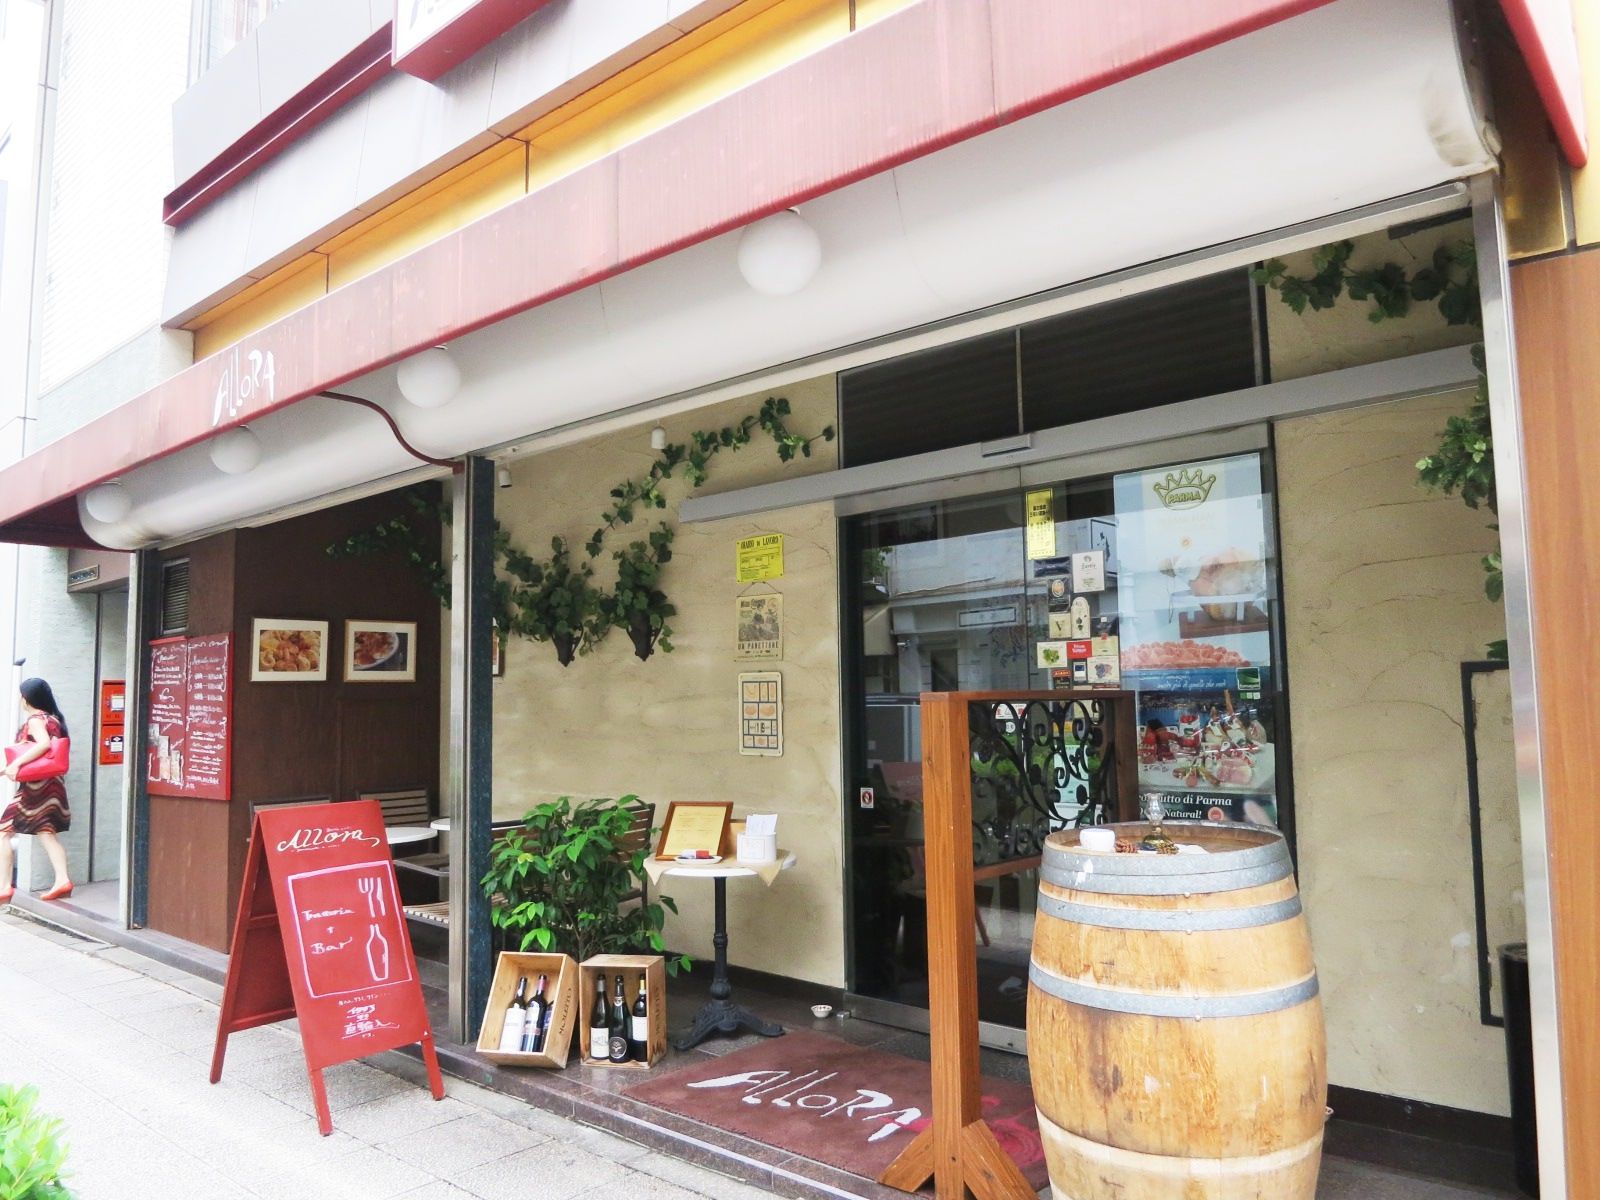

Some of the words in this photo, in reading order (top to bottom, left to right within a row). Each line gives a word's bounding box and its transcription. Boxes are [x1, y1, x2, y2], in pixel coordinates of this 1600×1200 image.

[1166, 490, 1202, 505] PARMA
[1183, 793, 1193, 804] di
[1196, 795, 1232, 806] Parma
[1163, 808, 1202, 819] Natural!
[277, 828, 380, 852] Allora
[311, 936, 353, 955] Bar
